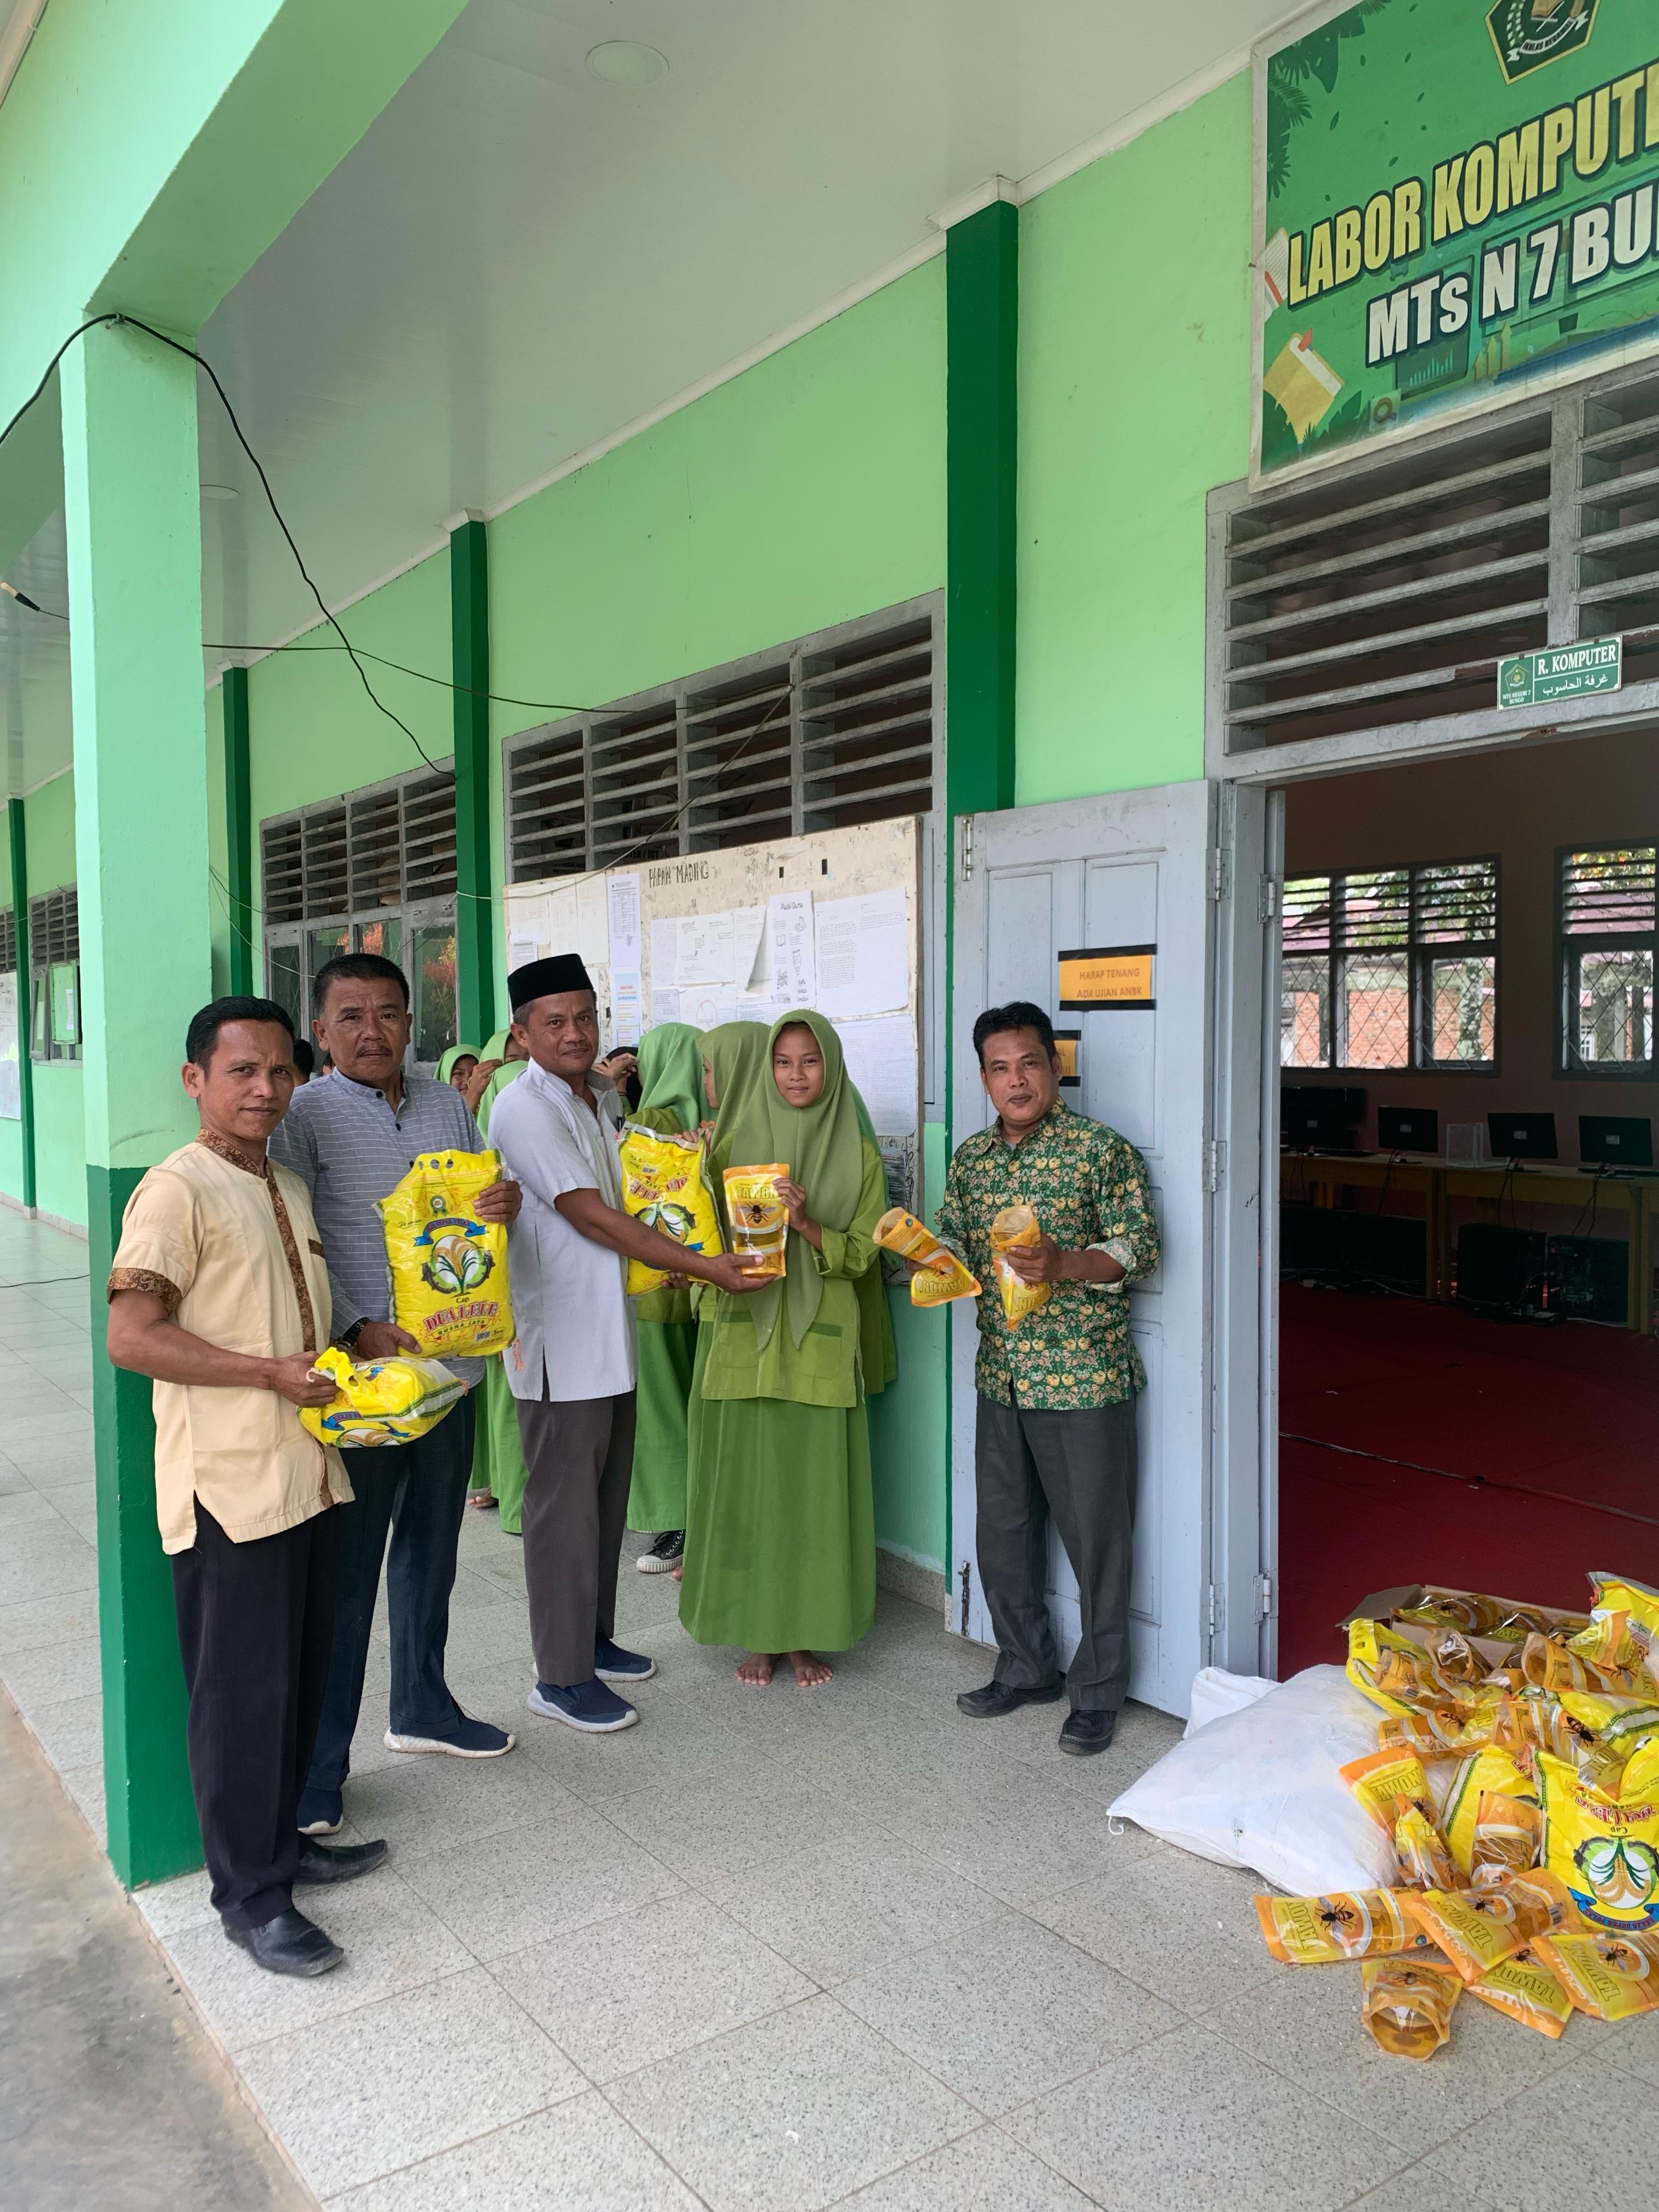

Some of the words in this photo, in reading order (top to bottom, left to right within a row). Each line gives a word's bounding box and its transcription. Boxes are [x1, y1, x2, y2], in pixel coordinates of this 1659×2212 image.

[1289, 179, 1423, 306] LABOR
[1481, 243, 1516, 319] N
[1530, 224, 1560, 299] 7
[1572, 182, 1659, 285] BU
[1538, 658, 1549, 675] R.
[1552, 644, 1616, 673] KOMPUTER
[1079, 969, 1105, 980] HARAP
[1106, 968, 1140, 978] TENANG
[1076, 989, 1093, 998] ADA
[1094, 988, 1118, 997] UJIAN
[1120, 986, 1142, 997] ANBK
[423, 1307, 458, 1333] DUA
[458, 1301, 499, 1319] LELE
[1368, 1769, 1423, 1802] TAWON
[1610, 1826, 1628, 1835] Cap
[1286, 1902, 1319, 1951] TAWON
[1441, 1904, 1493, 1949] TAWON
[1567, 1948, 1621, 2002] TAWON
